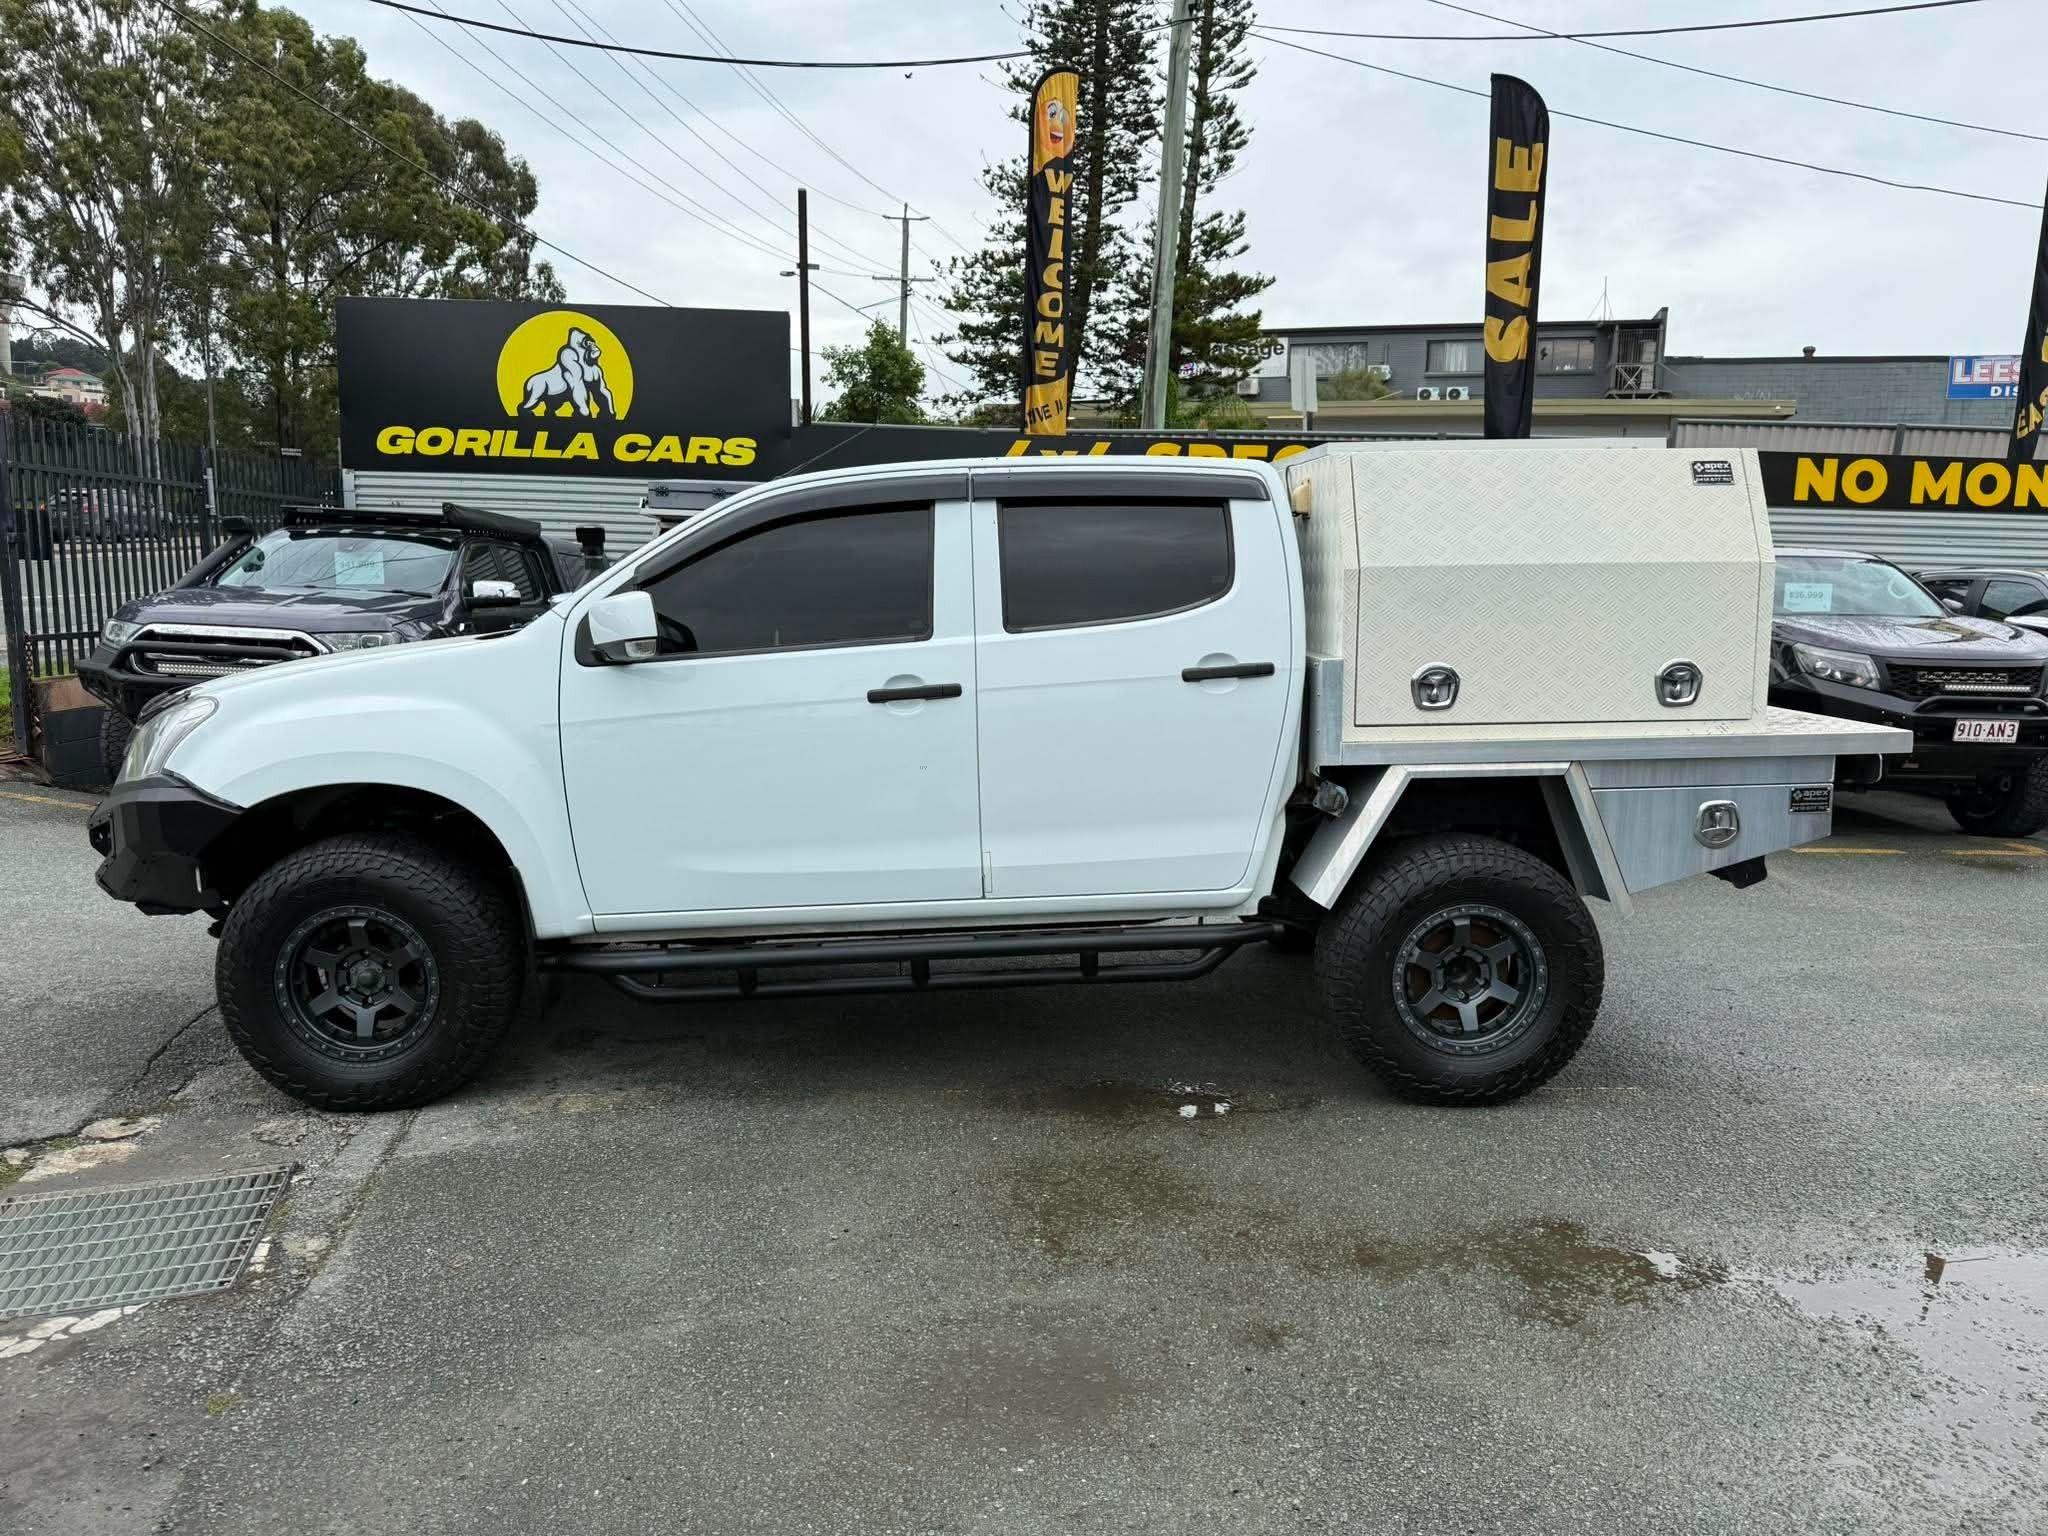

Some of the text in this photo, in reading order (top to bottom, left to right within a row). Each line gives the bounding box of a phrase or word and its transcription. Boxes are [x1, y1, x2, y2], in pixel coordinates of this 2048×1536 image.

[1034, 168, 1073, 377] WELCOME
[1484, 137, 1543, 362] SALE
[1208, 342, 1284, 360] assage
[376, 426, 757, 466] GORILLA CARS
[1793, 457, 2048, 508] NO MON
